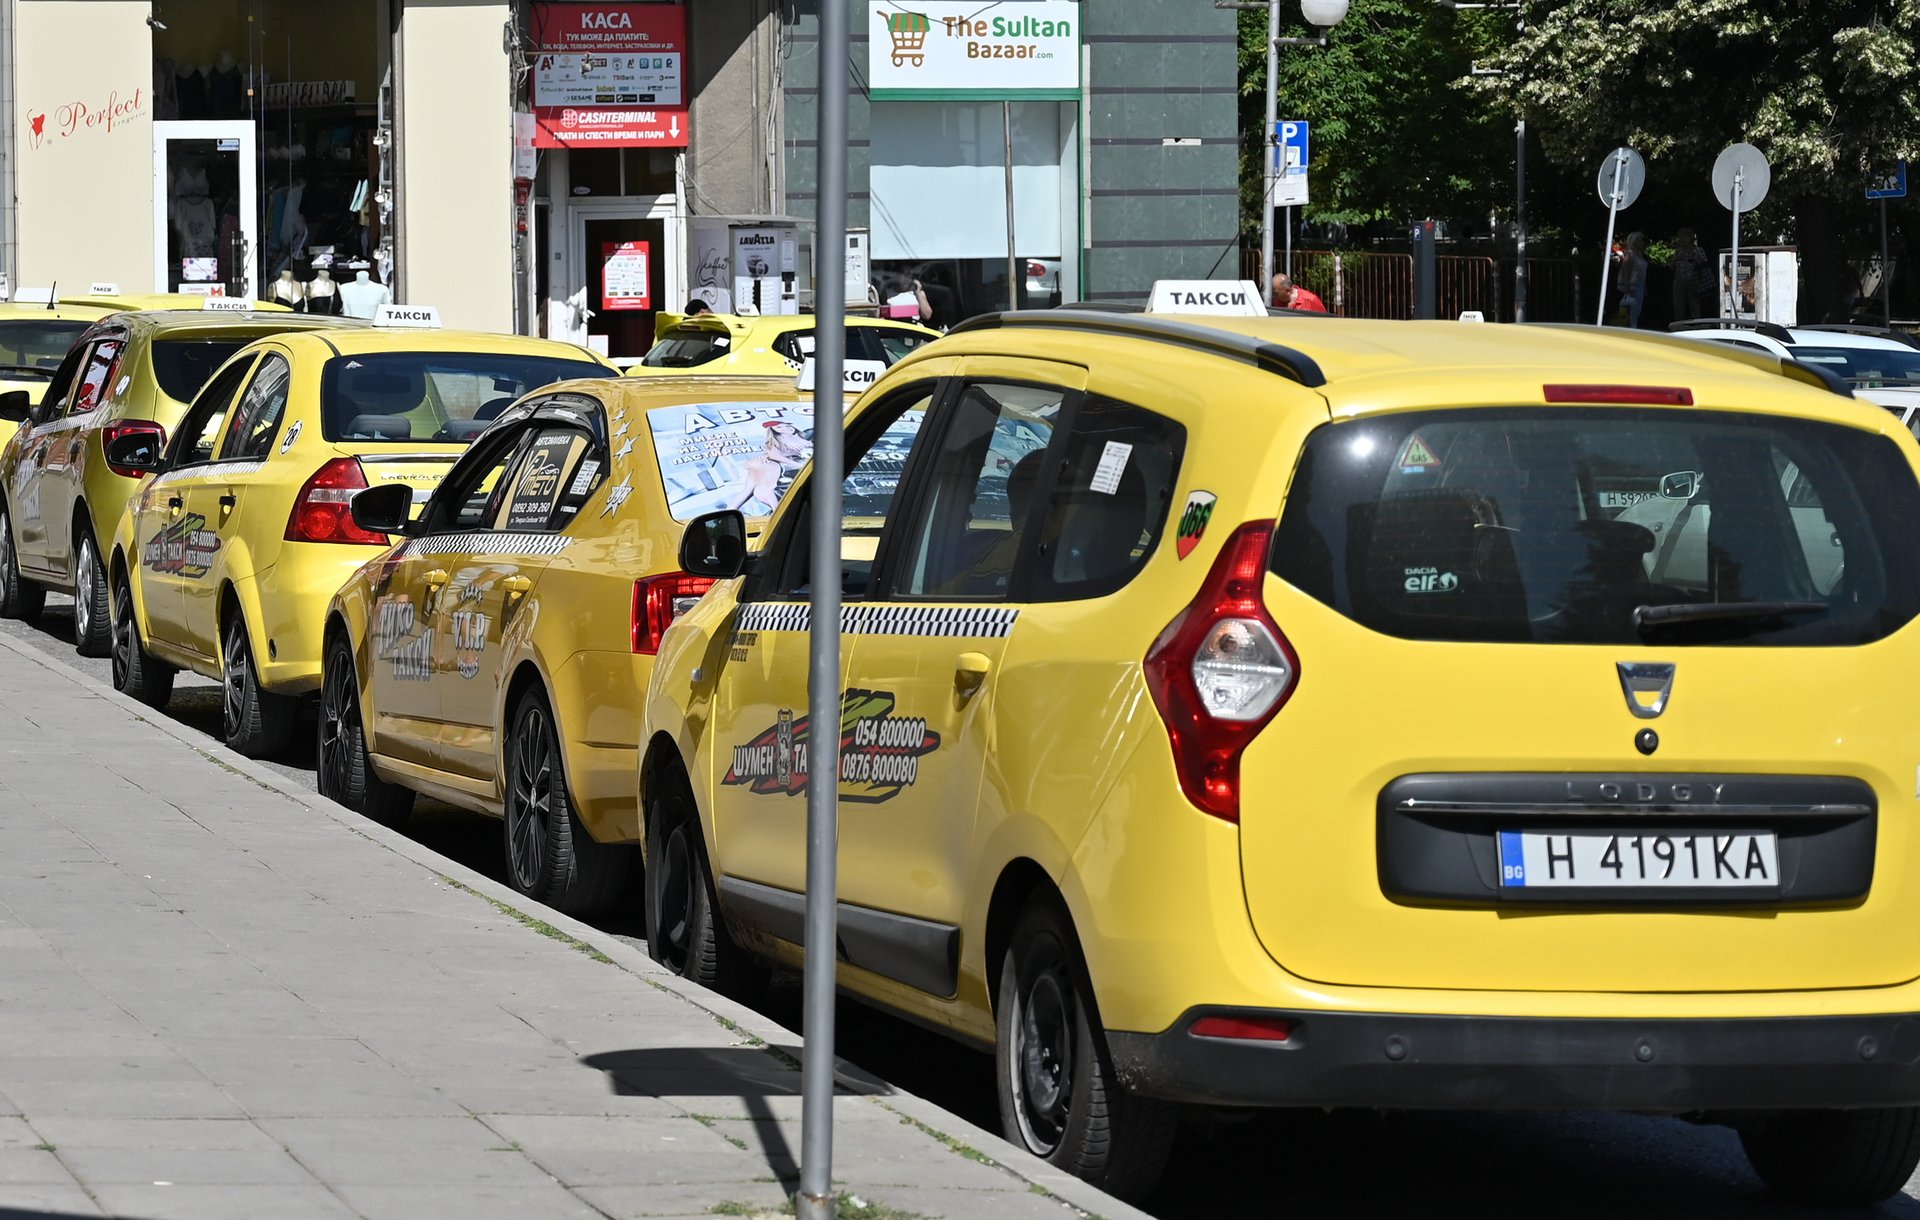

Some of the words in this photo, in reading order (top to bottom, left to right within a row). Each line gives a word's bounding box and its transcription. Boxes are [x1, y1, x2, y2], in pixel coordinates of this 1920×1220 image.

[582, 12, 632, 29] КАСА
[942, 15, 988, 37] The
[992, 15, 1070, 37] Sultan
[566, 33, 580, 41] ТУК
[580, 33, 602, 41] МОЖЕ
[54, 88, 143, 137] Perfect
[578, 111, 657, 124] CASHTERMINAL
[586, 131, 614, 140] СПЕСТИ
[614, 131, 637, 140] ВРЕМЕ
[645, 131, 665, 139] ПАРИ
[1282, 123, 1298, 142] P
[739, 233, 775, 246] LAVAZZA
[1170, 292, 1246, 306] ТАКСИ
[386, 310, 431, 321] ТАКСИ
[283, 428, 298, 447] 28
[680, 445, 701, 454] НА
[703, 439, 748, 450] КОЛИ
[1607, 492, 1616, 505] H
[1179, 501, 1212, 539] 066
[1404, 567, 1438, 575] DACIA
[1404, 574, 1438, 591] elf
[393, 627, 433, 678] ТАКСИ
[855, 718, 877, 748] 054
[878, 719, 925, 749] 800000
[733, 745, 775, 777] ШУМЕН
[842, 753, 871, 780] 0876
[871, 754, 918, 783] 800080
[1566, 782, 1726, 805] LODGY
[1546, 836, 1575, 880] H
[1504, 865, 1524, 879] BG
